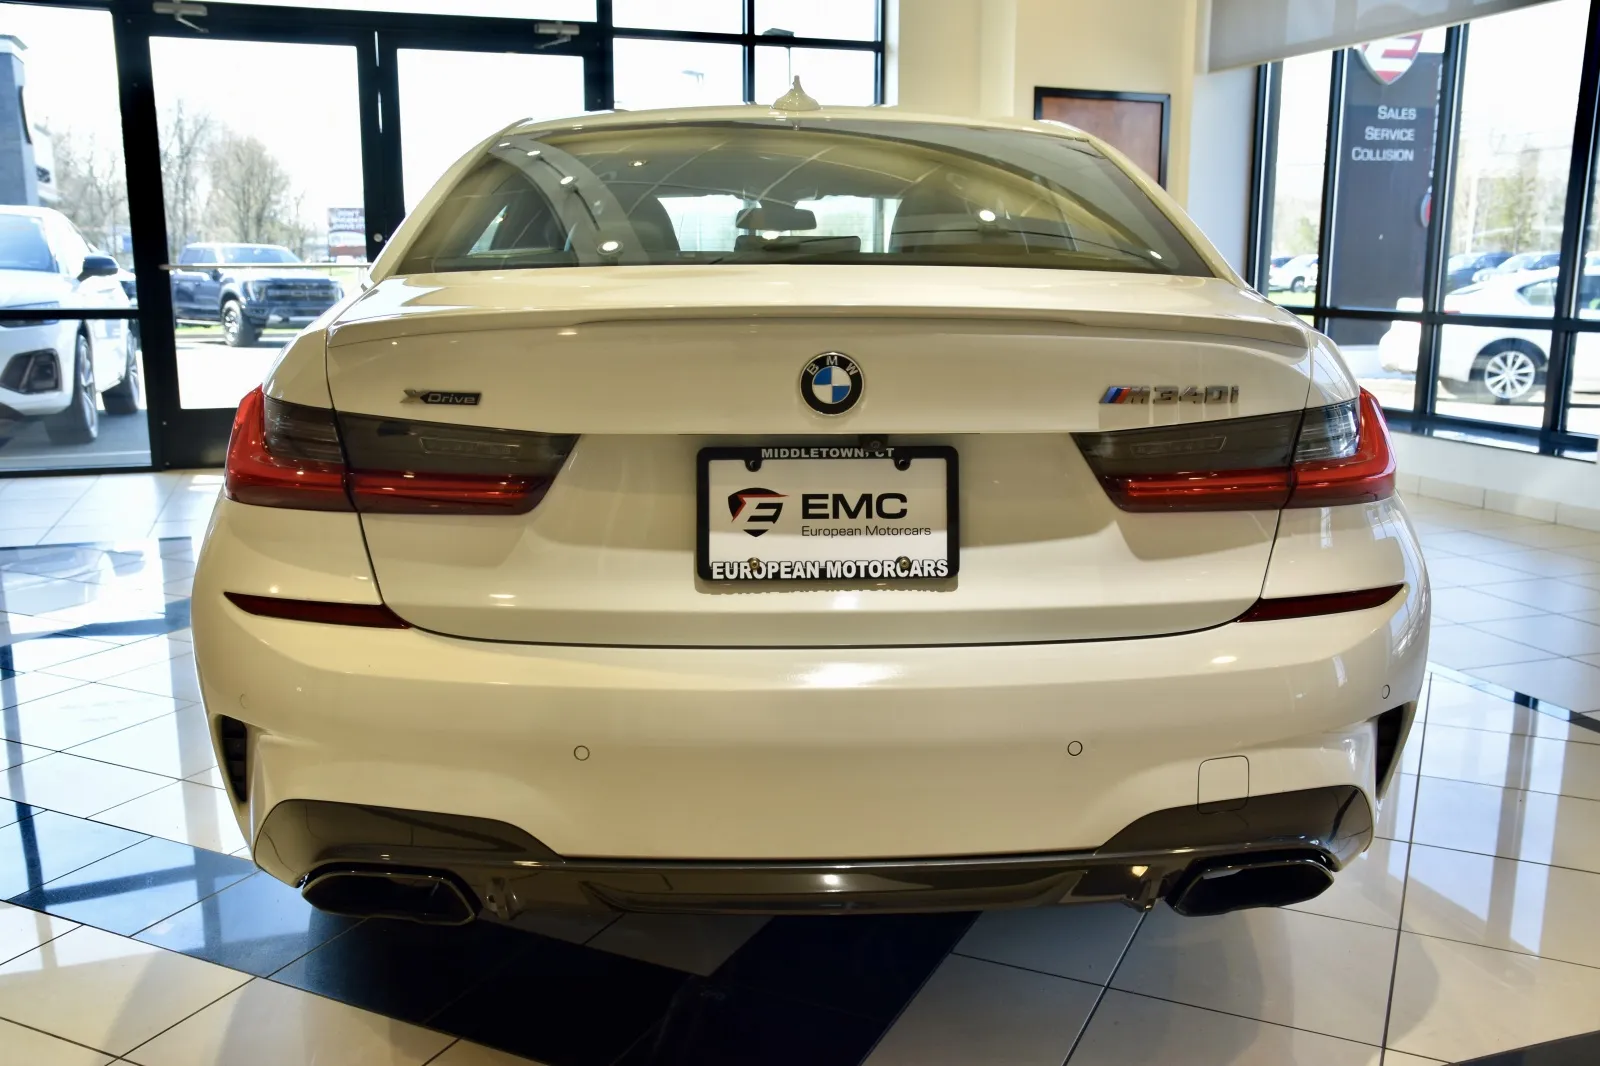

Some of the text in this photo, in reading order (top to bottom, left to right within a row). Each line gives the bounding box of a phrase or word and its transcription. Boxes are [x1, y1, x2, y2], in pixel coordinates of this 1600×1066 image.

[1377, 105, 1417, 121] SALES
[1364, 125, 1416, 142] SERVICE
[1351, 146, 1415, 162] COLLISION
[806, 355, 859, 376] BMW
[761, 447, 869, 459] MIDDLETOWN,
[801, 492, 908, 520] EMC
[801, 524, 932, 538] European Motorcars
[712, 559, 949, 579] EUROPEAN MOTORCARS
